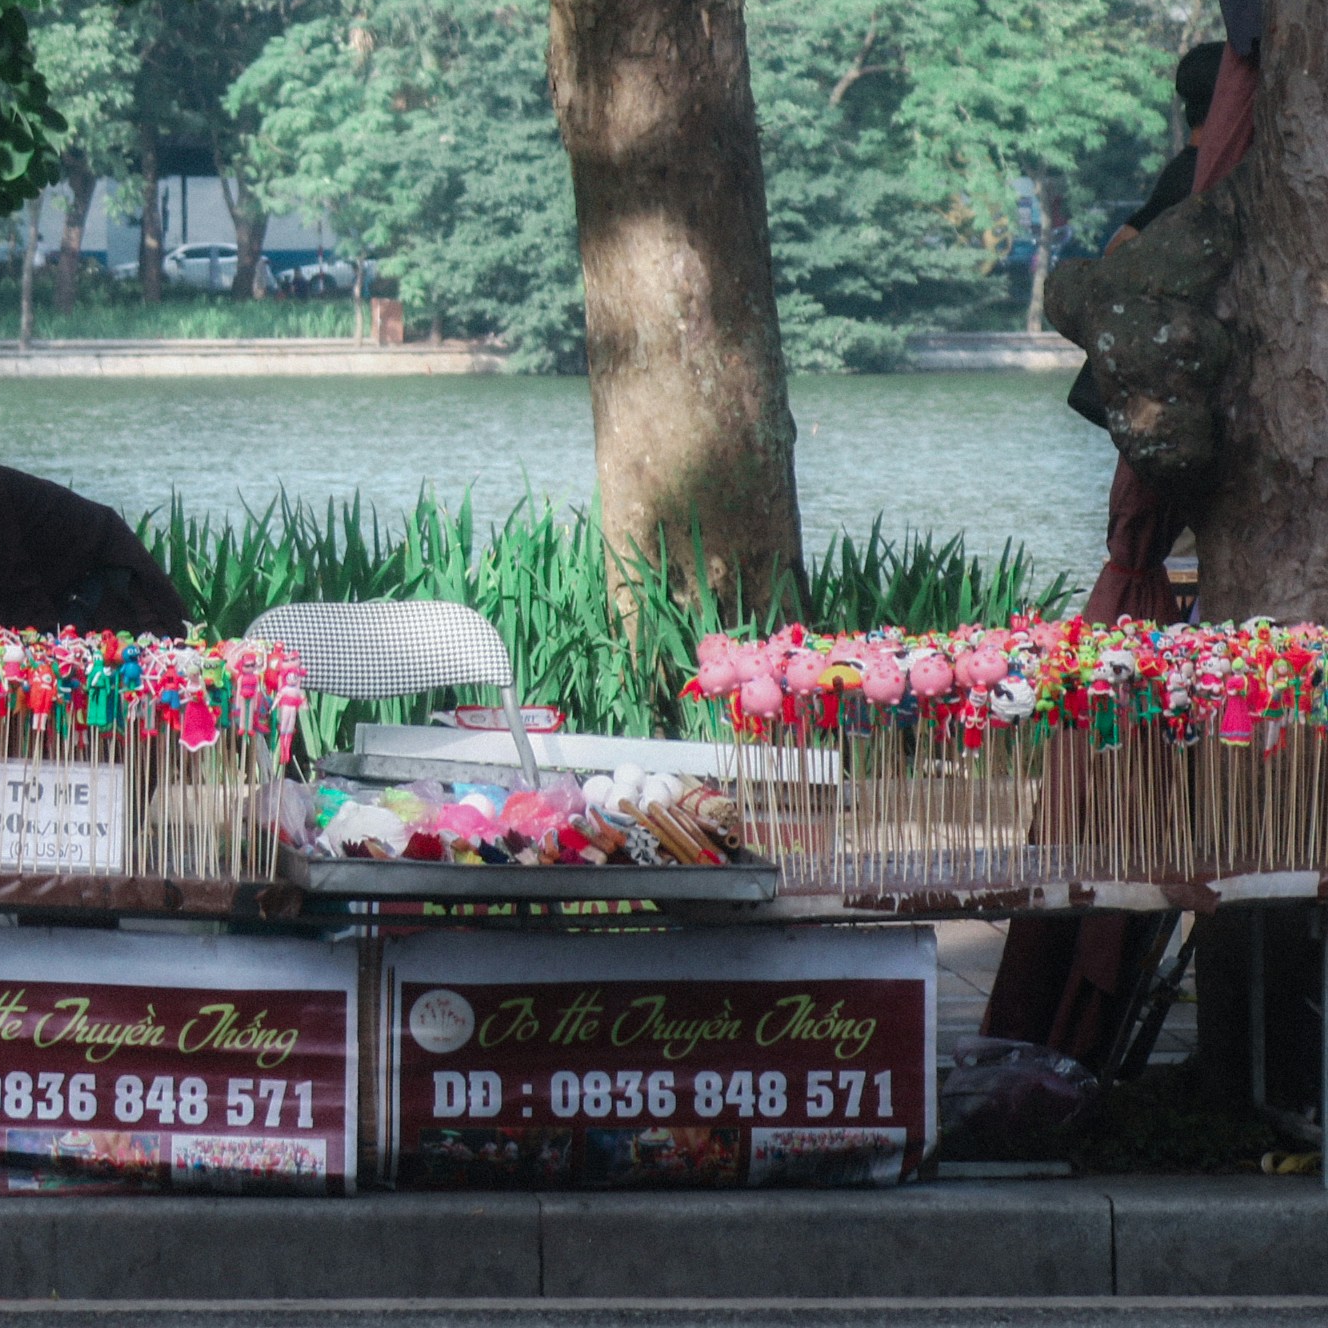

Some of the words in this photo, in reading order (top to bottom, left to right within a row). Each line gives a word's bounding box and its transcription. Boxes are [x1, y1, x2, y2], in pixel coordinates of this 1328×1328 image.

[34, 997, 166, 1064] Truyền
[178, 1003, 300, 1069] Thống
[478, 997, 540, 1048] Tò
[548, 987, 604, 1045] He
[610, 994, 742, 1061] Truyền
[755, 994, 877, 1061] Thống
[114, 1074, 209, 1126] 848
[227, 1078, 314, 1129] 571
[433, 1070, 502, 1118] DĐ
[550, 1070, 677, 1118] 0836
[694, 1070, 788, 1118] 848
[806, 1070, 894, 1118] 571
